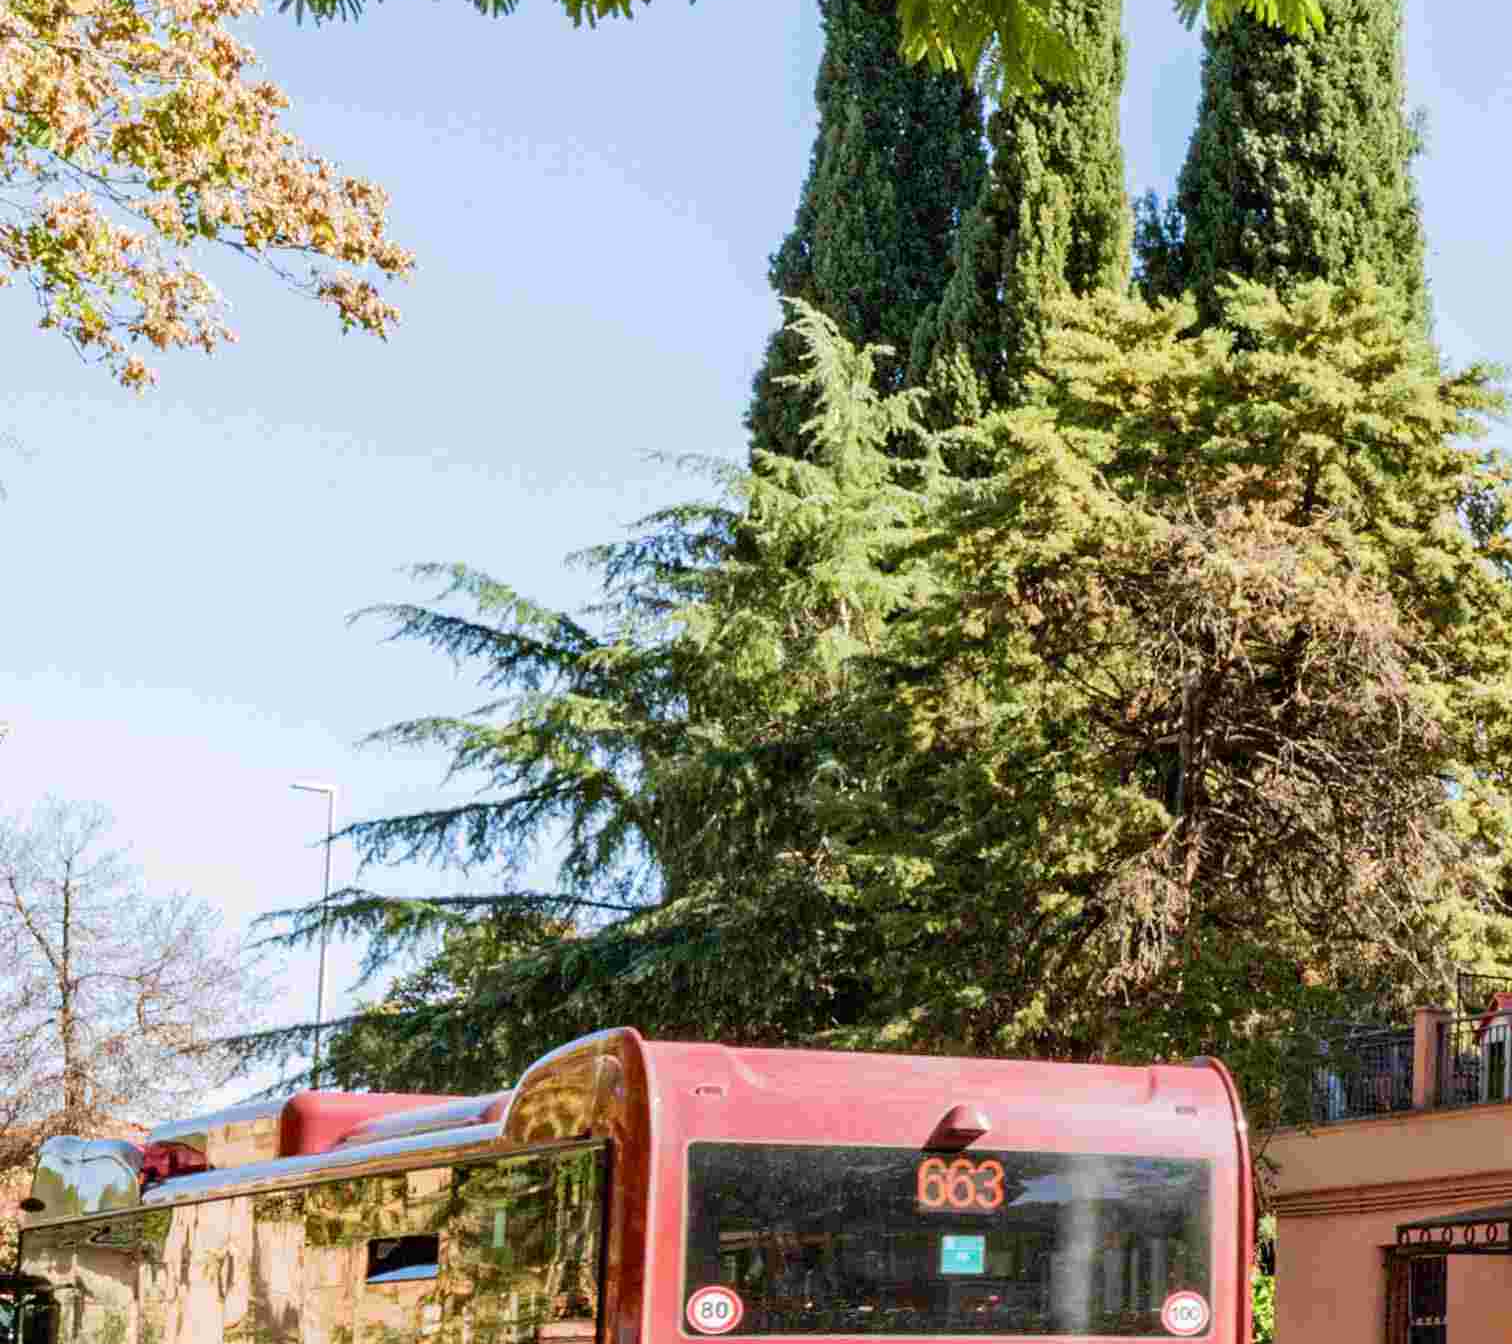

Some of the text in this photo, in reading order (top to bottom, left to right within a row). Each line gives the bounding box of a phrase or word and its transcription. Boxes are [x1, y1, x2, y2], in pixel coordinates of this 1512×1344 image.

[916, 1156, 1006, 1208] 663
[700, 1300, 730, 1319] 80
[1172, 1304, 1200, 1321] 100
